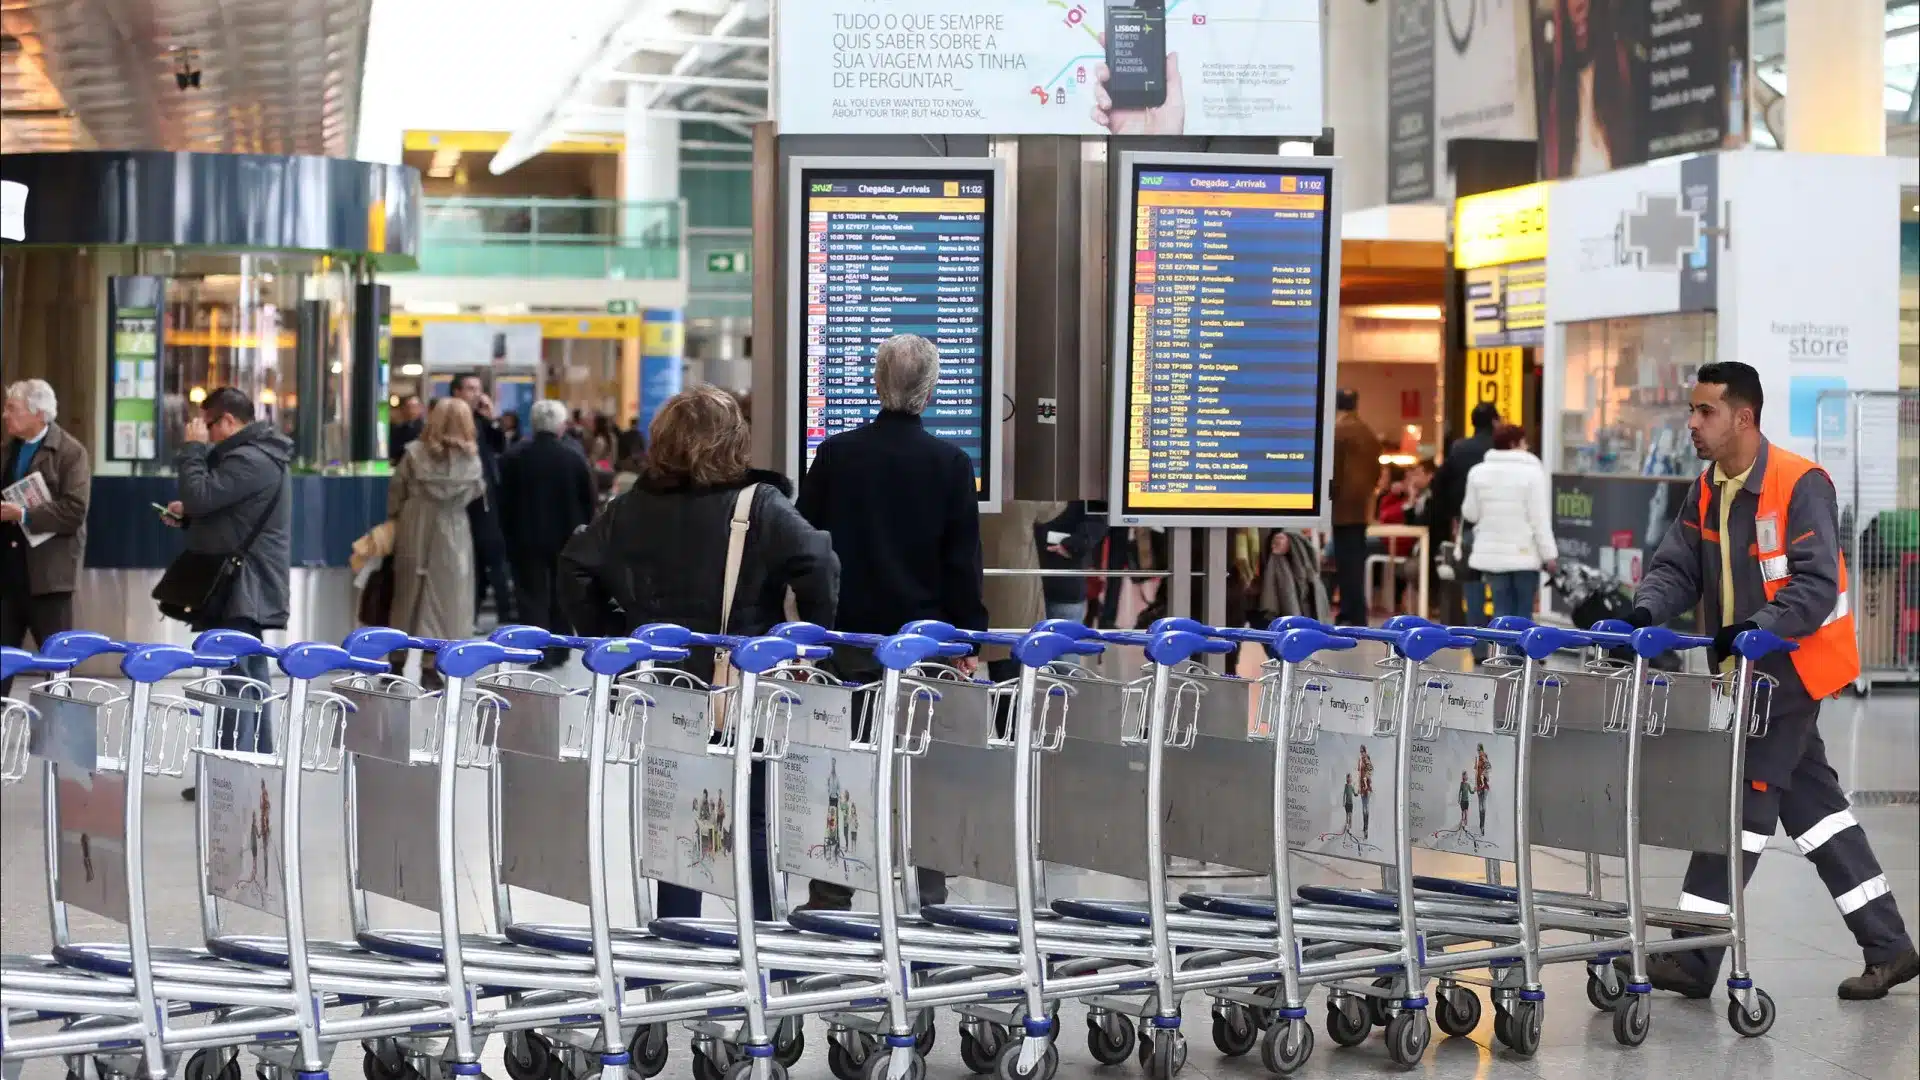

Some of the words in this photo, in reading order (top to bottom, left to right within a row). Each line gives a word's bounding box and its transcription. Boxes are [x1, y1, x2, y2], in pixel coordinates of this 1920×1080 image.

[833, 13, 880, 30] TUDO
[885, 14, 897, 30] O
[902, 14, 935, 33] QUE
[940, 15, 1004, 30] SEMPRE
[833, 34, 871, 52] QUIS
[876, 34, 925, 49] SABER
[930, 34, 982, 50] SOBRE
[986, 35, 997, 50] A
[833, 53, 865, 69] SUA
[870, 53, 932, 69] VIAGEM
[937, 54, 974, 69] MAS
[978, 54, 1027, 70] TINHA
[833, 73, 856, 88] DE
[860, 73, 964, 91] PERGUNTAR_
[833, 99, 847, 107] ALL
[851, 99, 868, 107] YOU
[870, 99, 891, 108] EVER
[894, 99, 930, 108] WANTED
[933, 100, 944, 108] TO
[946, 100, 973, 108] KNOW
[832, 109, 862, 118] ABOUT
[865, 109, 888, 118] YOUR
[912, 110, 928, 118] BUT
[931, 110, 949, 118] HAD
[952, 110, 963, 118] TO
[1191, 179, 1229, 188] Chegadas
[1299, 181, 1321, 189] 11:02
[859, 184, 895, 195] Chegadas
[1771, 320, 1849, 337] healthcare
[1789, 337, 1848, 356] store
[659, 759, 664, 767] DE
[785, 753, 809, 764] ARRINHOS
[784, 762, 791, 770] DE
